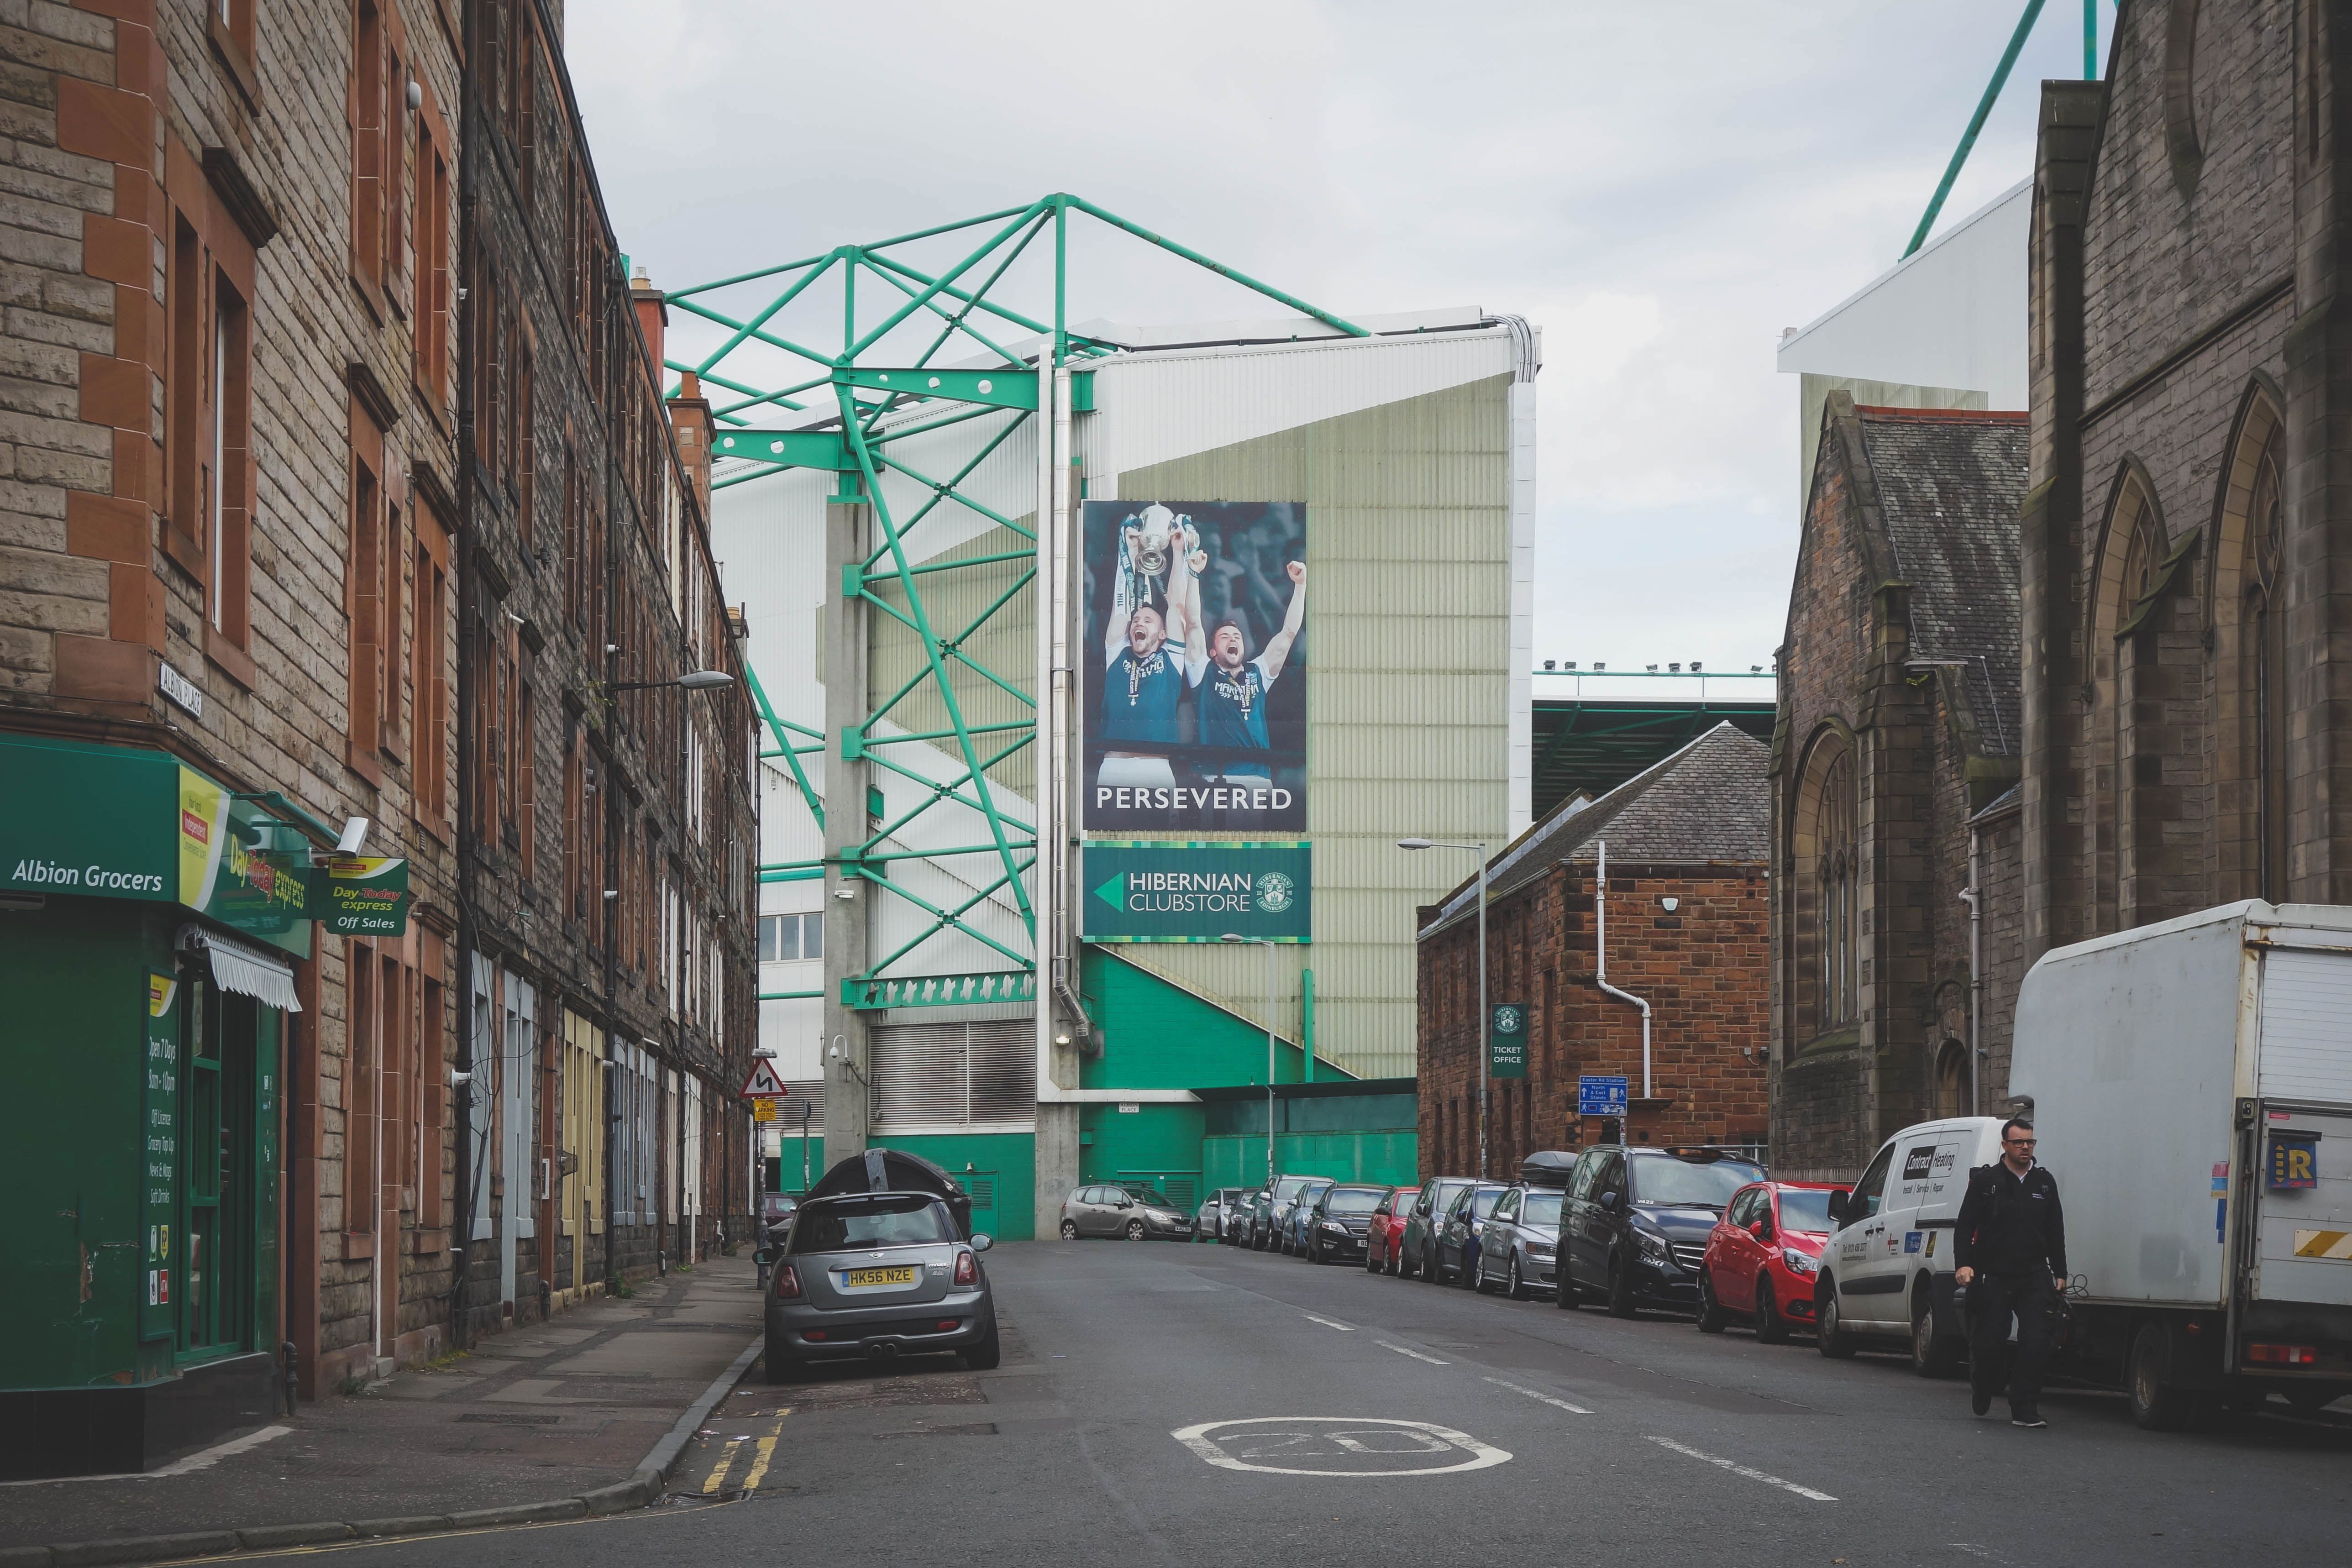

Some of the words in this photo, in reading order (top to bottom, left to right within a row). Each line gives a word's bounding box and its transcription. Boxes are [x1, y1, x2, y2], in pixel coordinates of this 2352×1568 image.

[163, 667, 182, 702] ALBION
[184, 683, 200, 714] PLACE
[1097, 787, 1292, 809] PERSEVERED
[11, 859, 79, 885] Albion
[85, 865, 163, 892] Grocers
[230, 833, 275, 903] Day-Today
[275, 870, 305, 910] express
[1259, 874, 1291, 886] HIBERNIAN
[1130, 872, 1251, 891] HIBERNIAN
[333, 886, 402, 902] Day-Today
[1129, 893, 1251, 912] CLUBSTORE
[341, 901, 393, 912] express
[1260, 900, 1290, 911] EDINBURGH
[338, 917, 359, 929] Off
[362, 918, 395, 928] Sales
[161, 1038, 164, 1058] 7
[164, 1038, 175, 1065] Days
[163, 1070, 174, 1096] 10pm
[158, 1109, 171, 1126] Licence
[148, 1135, 162, 1154] Grocery
[168, 1137, 174, 1156] Up
[1907, 1154, 1932, 1170] Contract
[1932, 1150, 1955, 1171] Heating
[2289, 1149, 2313, 1179] R
[149, 1162, 158, 1177] News
[163, 1162, 172, 1181] Mags
[158, 1188, 169, 1203] Drinks
[1916, 1184, 1930, 1193] Service
[1932, 1183, 1944, 1194] Repair
[1640, 1253, 1664, 1267] TAXI
[850, 1271, 883, 1284] HK56
[886, 1269, 911, 1282] NZE
